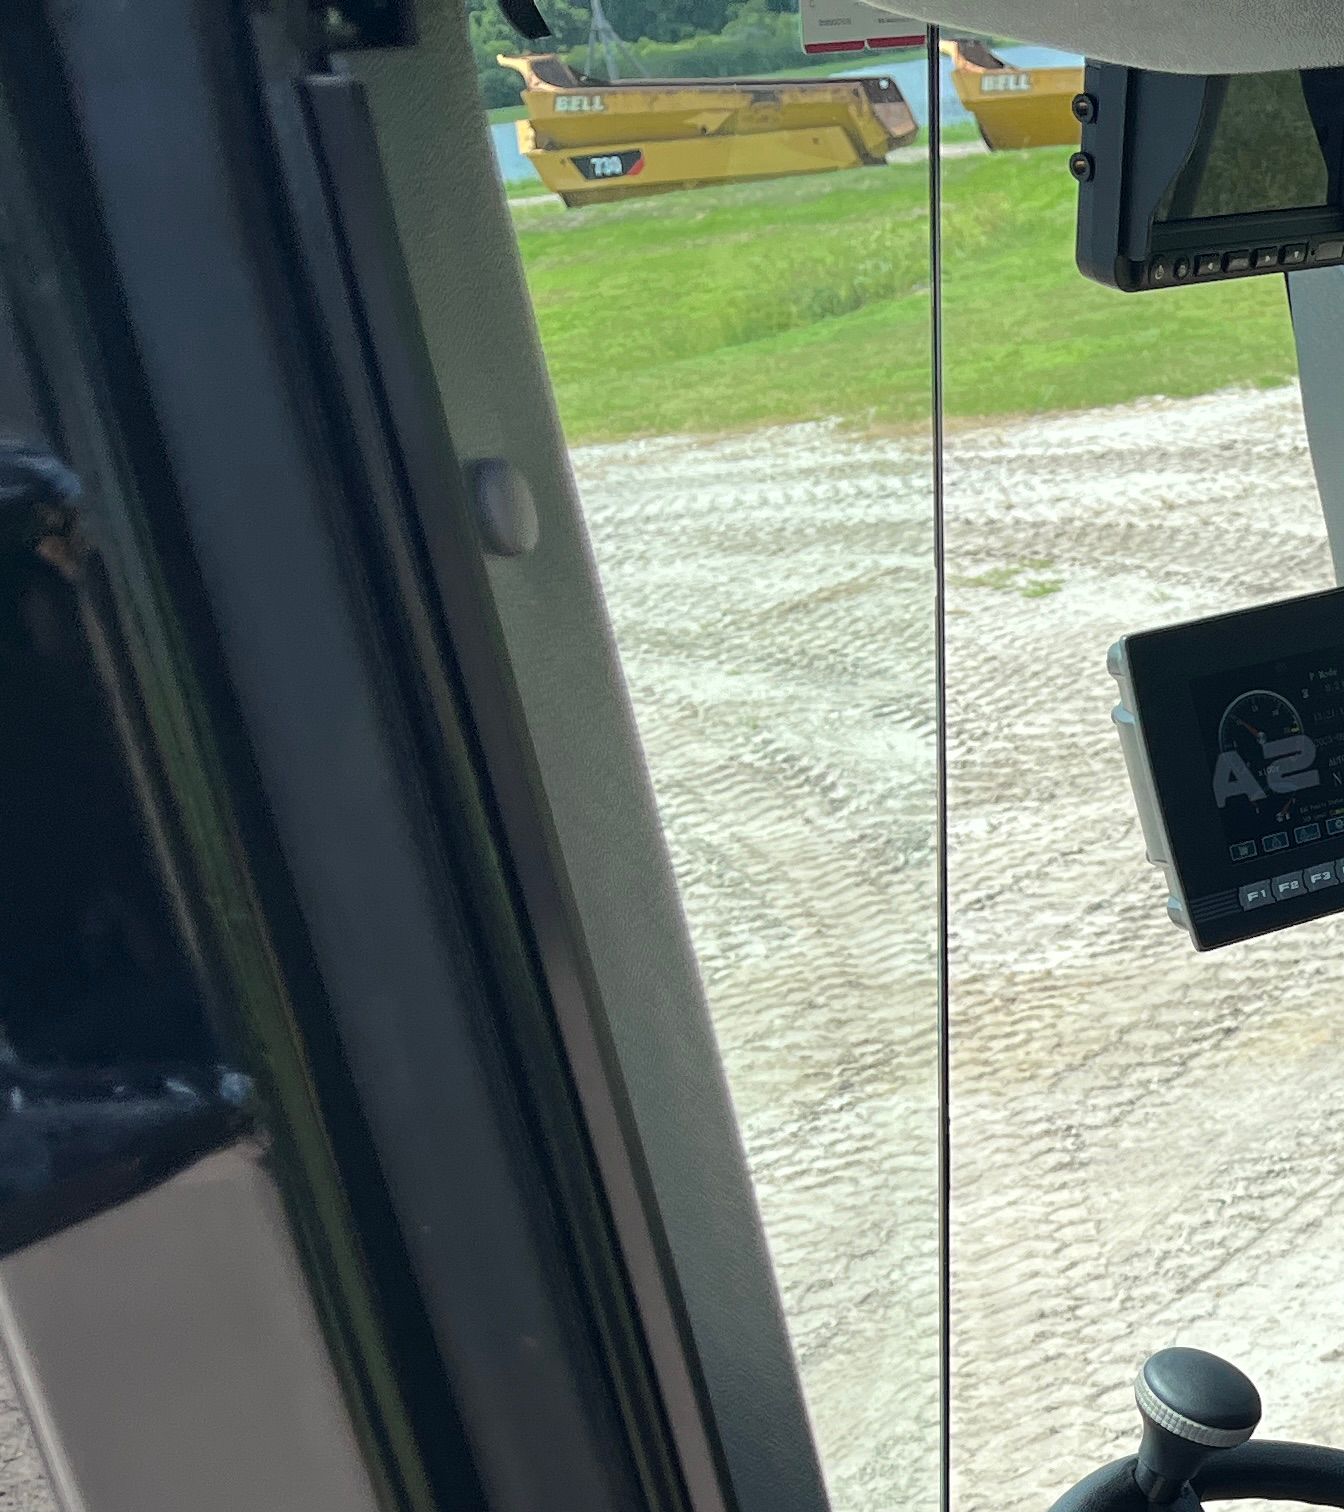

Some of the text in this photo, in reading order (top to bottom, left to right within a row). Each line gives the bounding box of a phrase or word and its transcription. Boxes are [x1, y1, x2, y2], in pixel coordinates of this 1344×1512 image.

[554, 94, 605, 113] BELL
[1247, 889, 1267, 902] F1
[1278, 881, 1299, 893] F2
[1310, 871, 1331, 884] F3
